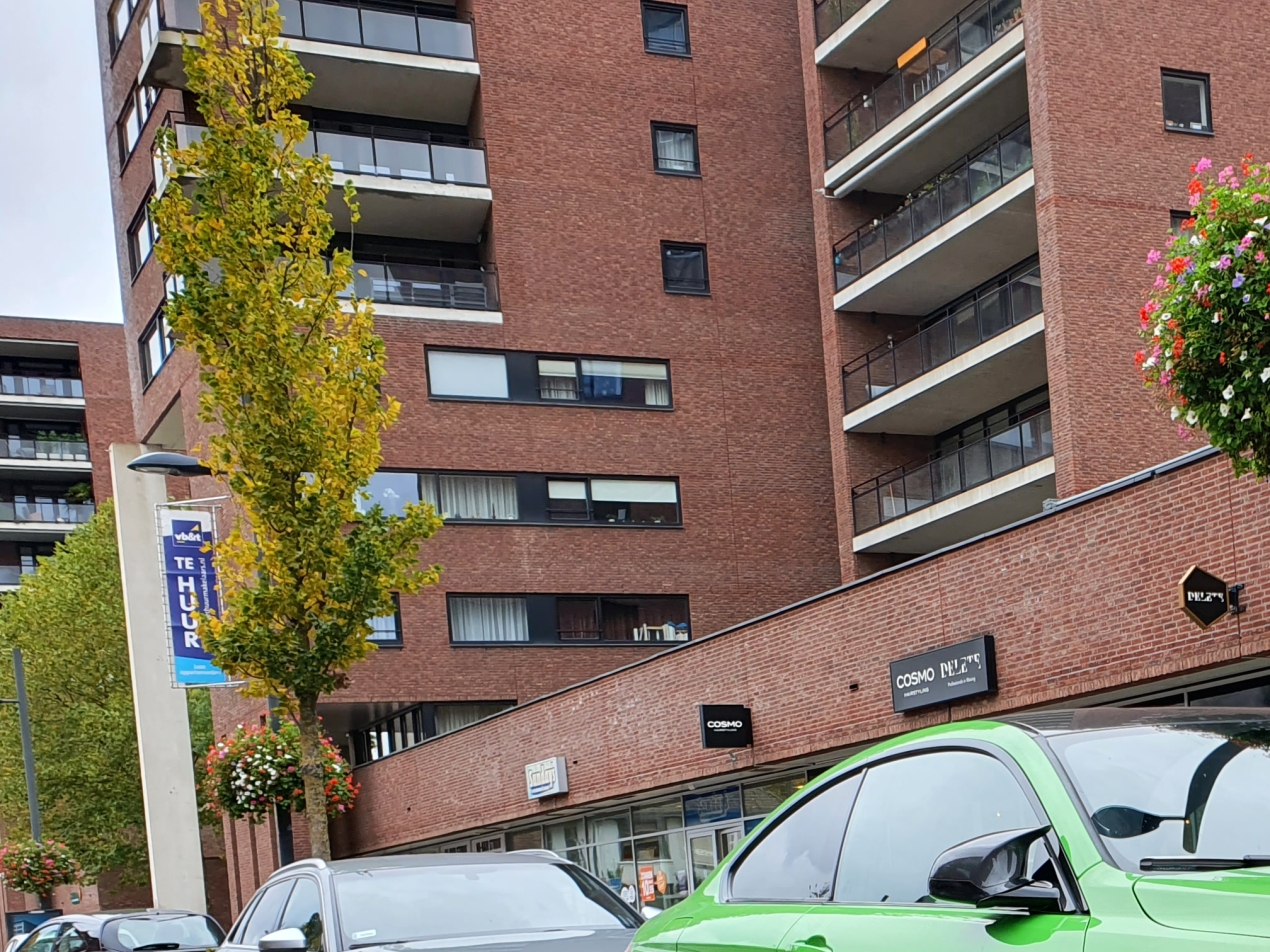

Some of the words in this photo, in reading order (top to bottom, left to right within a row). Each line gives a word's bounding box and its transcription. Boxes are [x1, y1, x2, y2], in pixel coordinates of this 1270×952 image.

[173, 556, 195, 570] TE
[177, 576, 201, 648] HUUR
[896, 667, 935, 689] COSMO
[707, 720, 743, 728] COSMO
